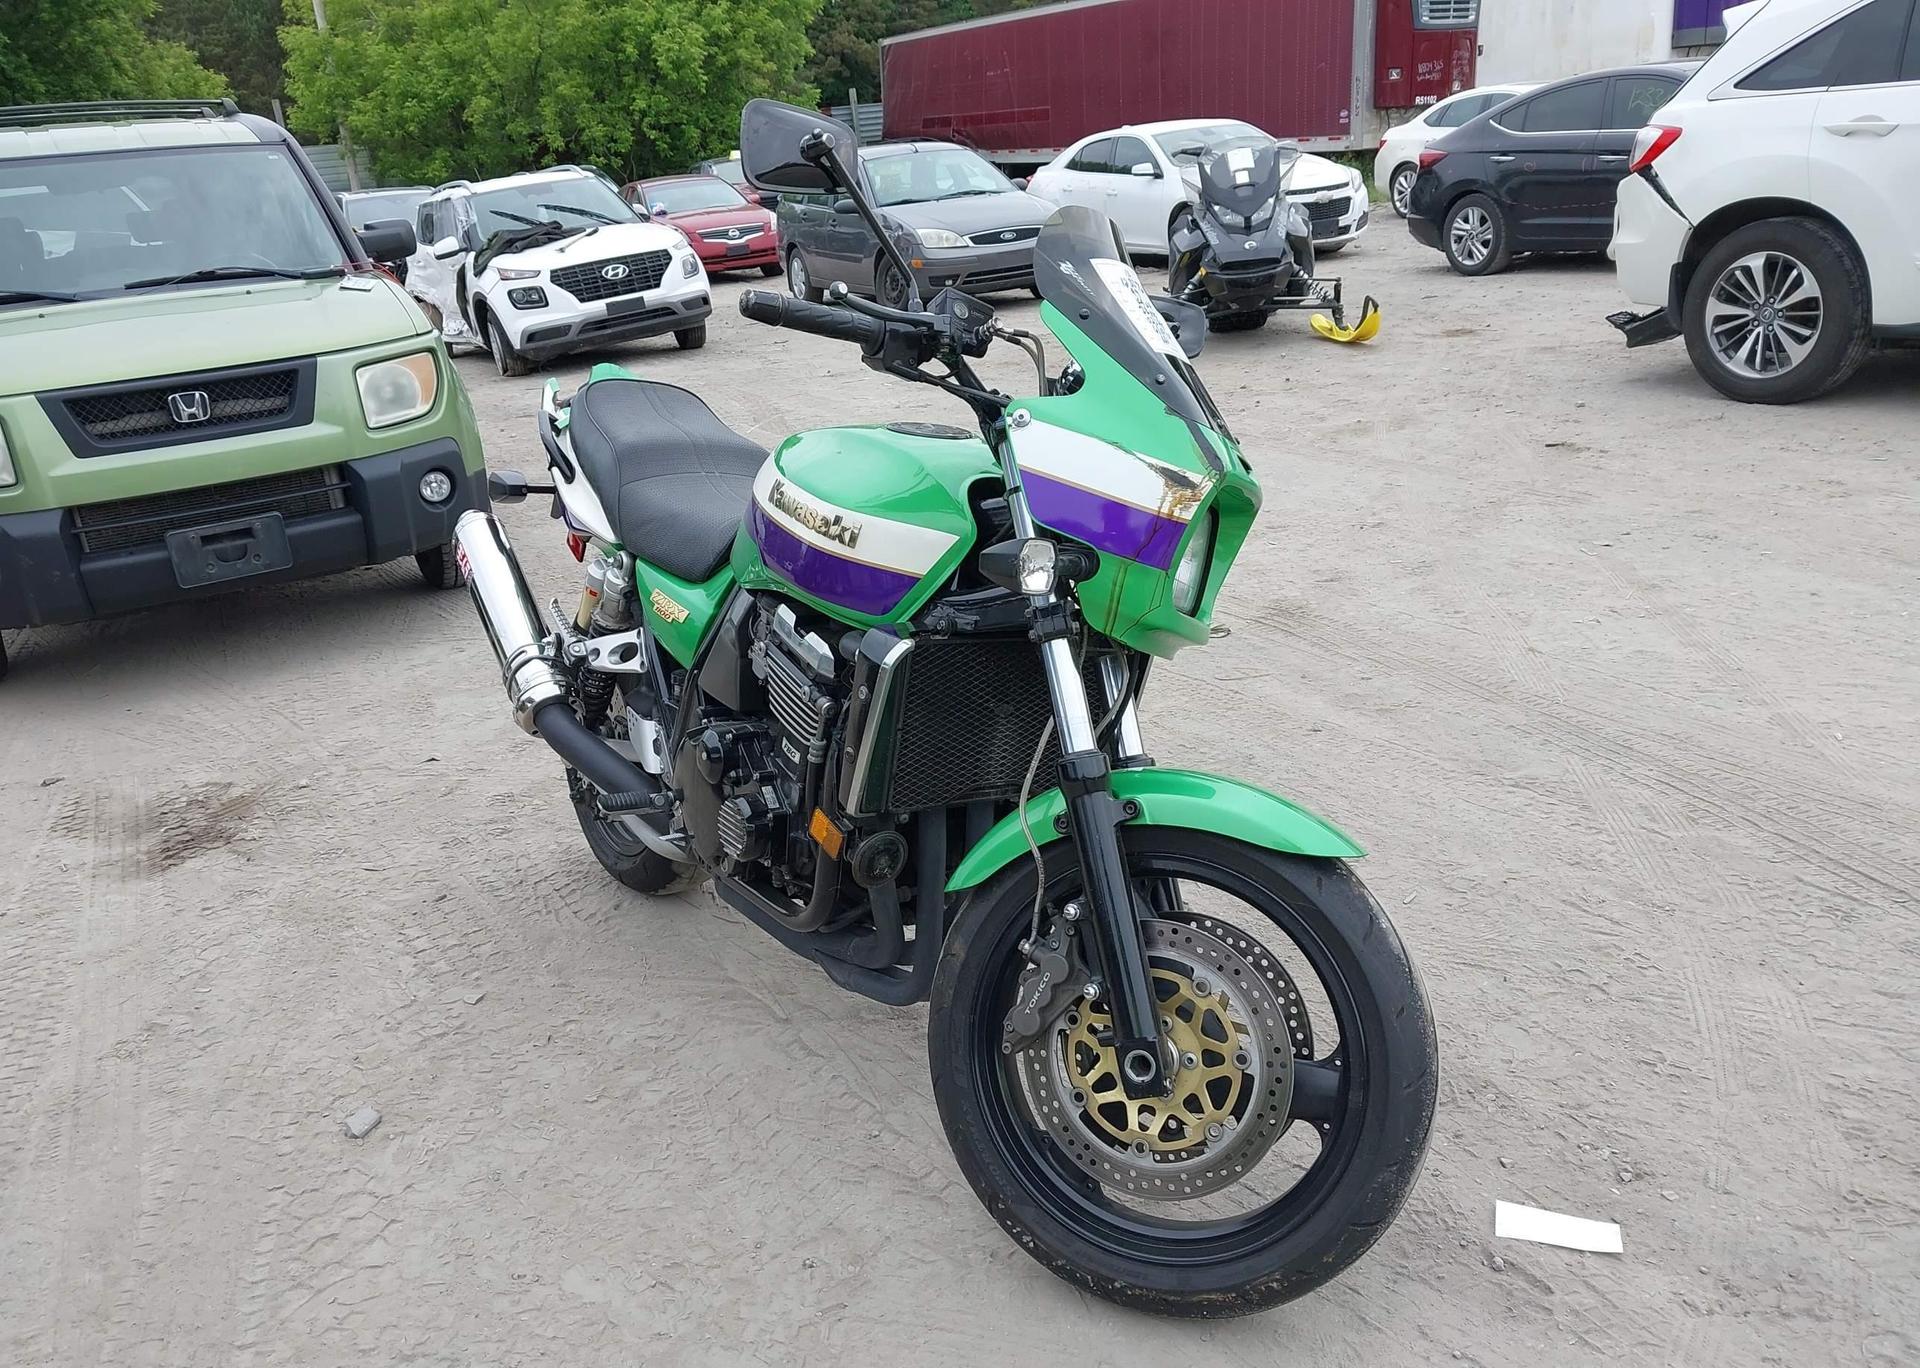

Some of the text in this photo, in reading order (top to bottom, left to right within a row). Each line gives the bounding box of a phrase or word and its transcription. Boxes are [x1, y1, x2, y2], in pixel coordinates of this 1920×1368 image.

[767, 478, 863, 549] Kawasaki
[783, 743, 797, 759] FBG
[1025, 972, 1051, 1015] TOKICO
